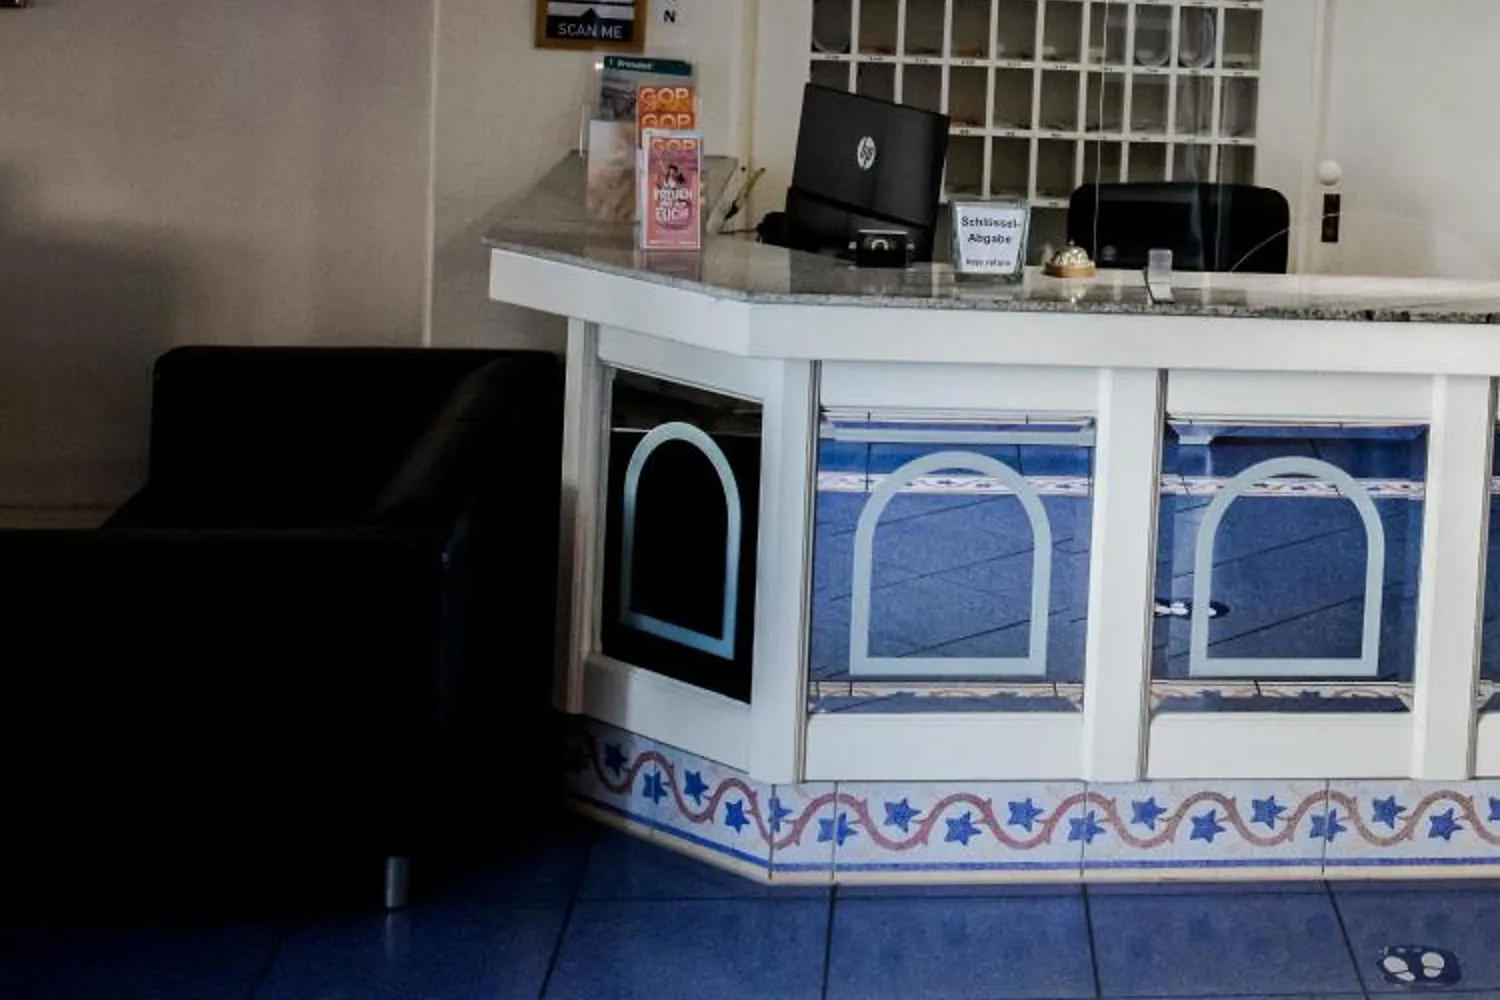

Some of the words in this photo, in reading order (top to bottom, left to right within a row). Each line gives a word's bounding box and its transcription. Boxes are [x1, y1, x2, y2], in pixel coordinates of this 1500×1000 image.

[558, 23, 597, 37] SCAN
[602, 24, 623, 39] ME
[640, 87, 690, 102] GOP
[641, 113, 692, 128] GOP
[652, 139, 696, 151] GOP
[967, 233, 1012, 245] Abgabe
